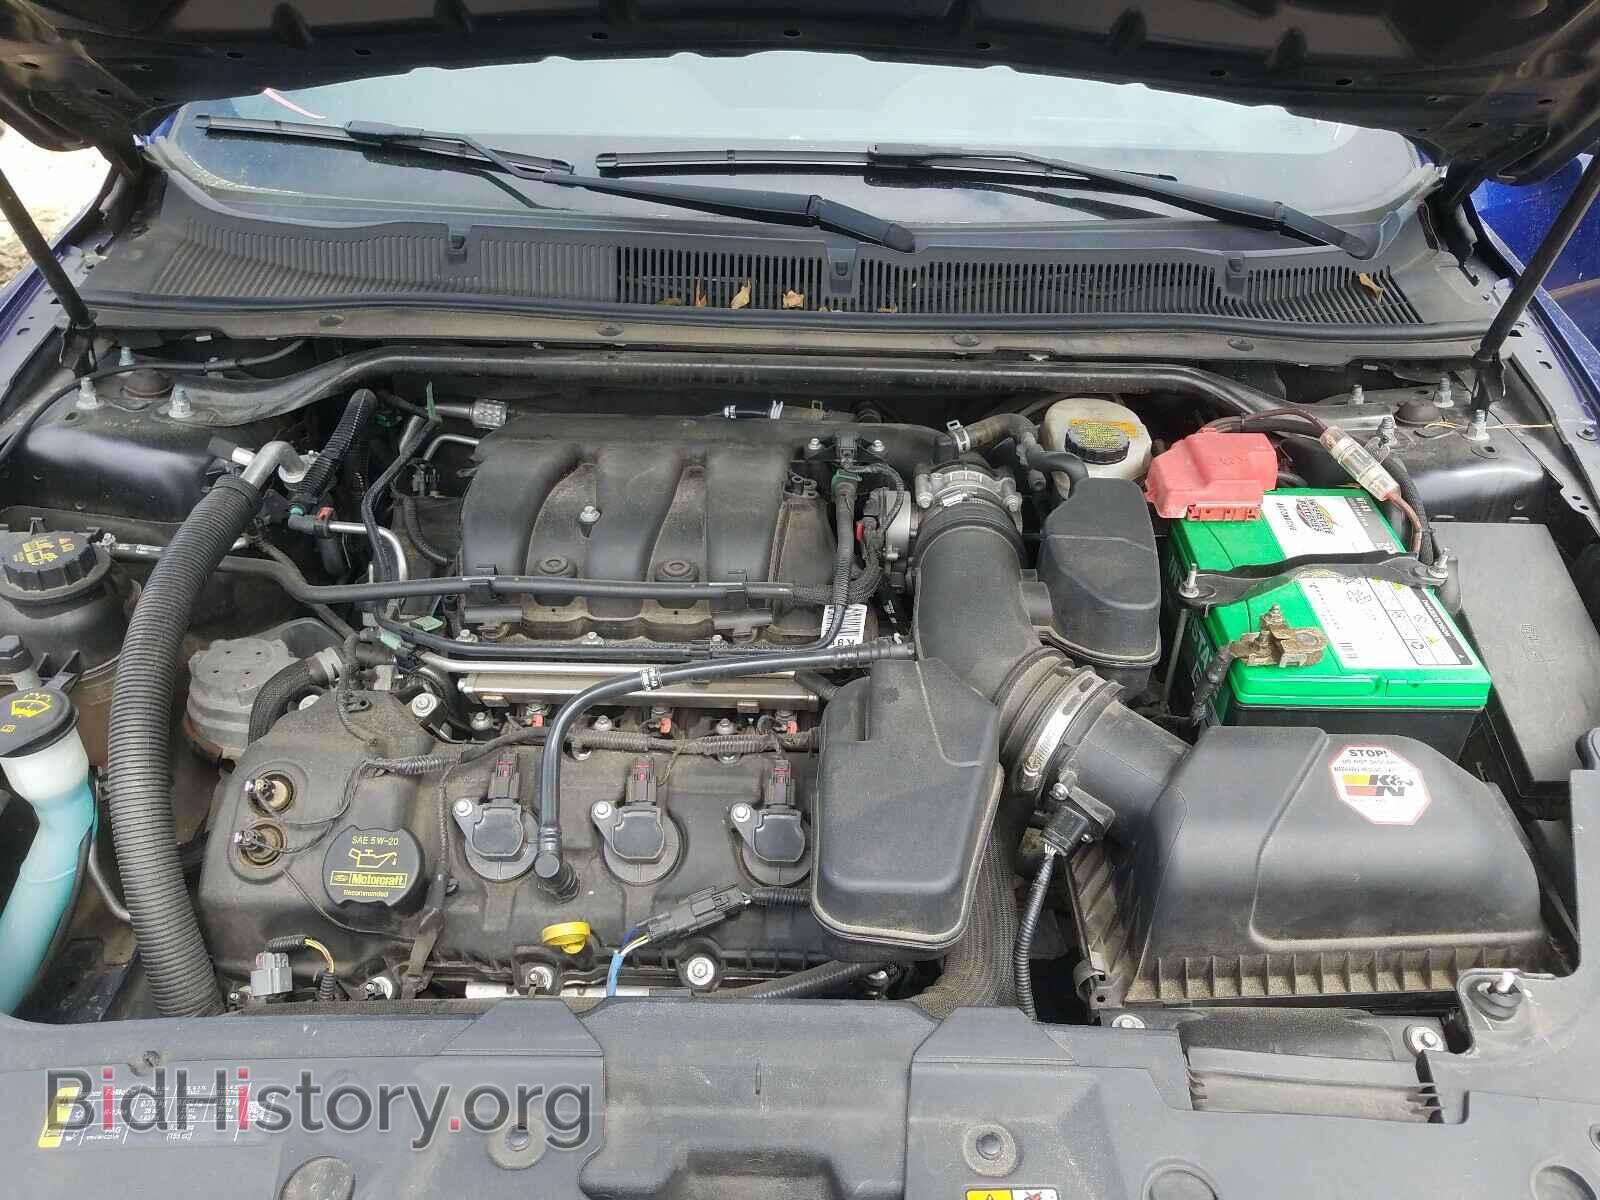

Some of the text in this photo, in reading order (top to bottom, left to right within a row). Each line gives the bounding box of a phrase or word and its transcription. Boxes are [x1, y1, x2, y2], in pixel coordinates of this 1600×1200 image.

[1348, 749, 1387, 757] STOP!
[351, 836, 399, 846] SAE 5W-20
[351, 873, 404, 886] Motorcraft
[343, 889, 389, 898] Recommended
